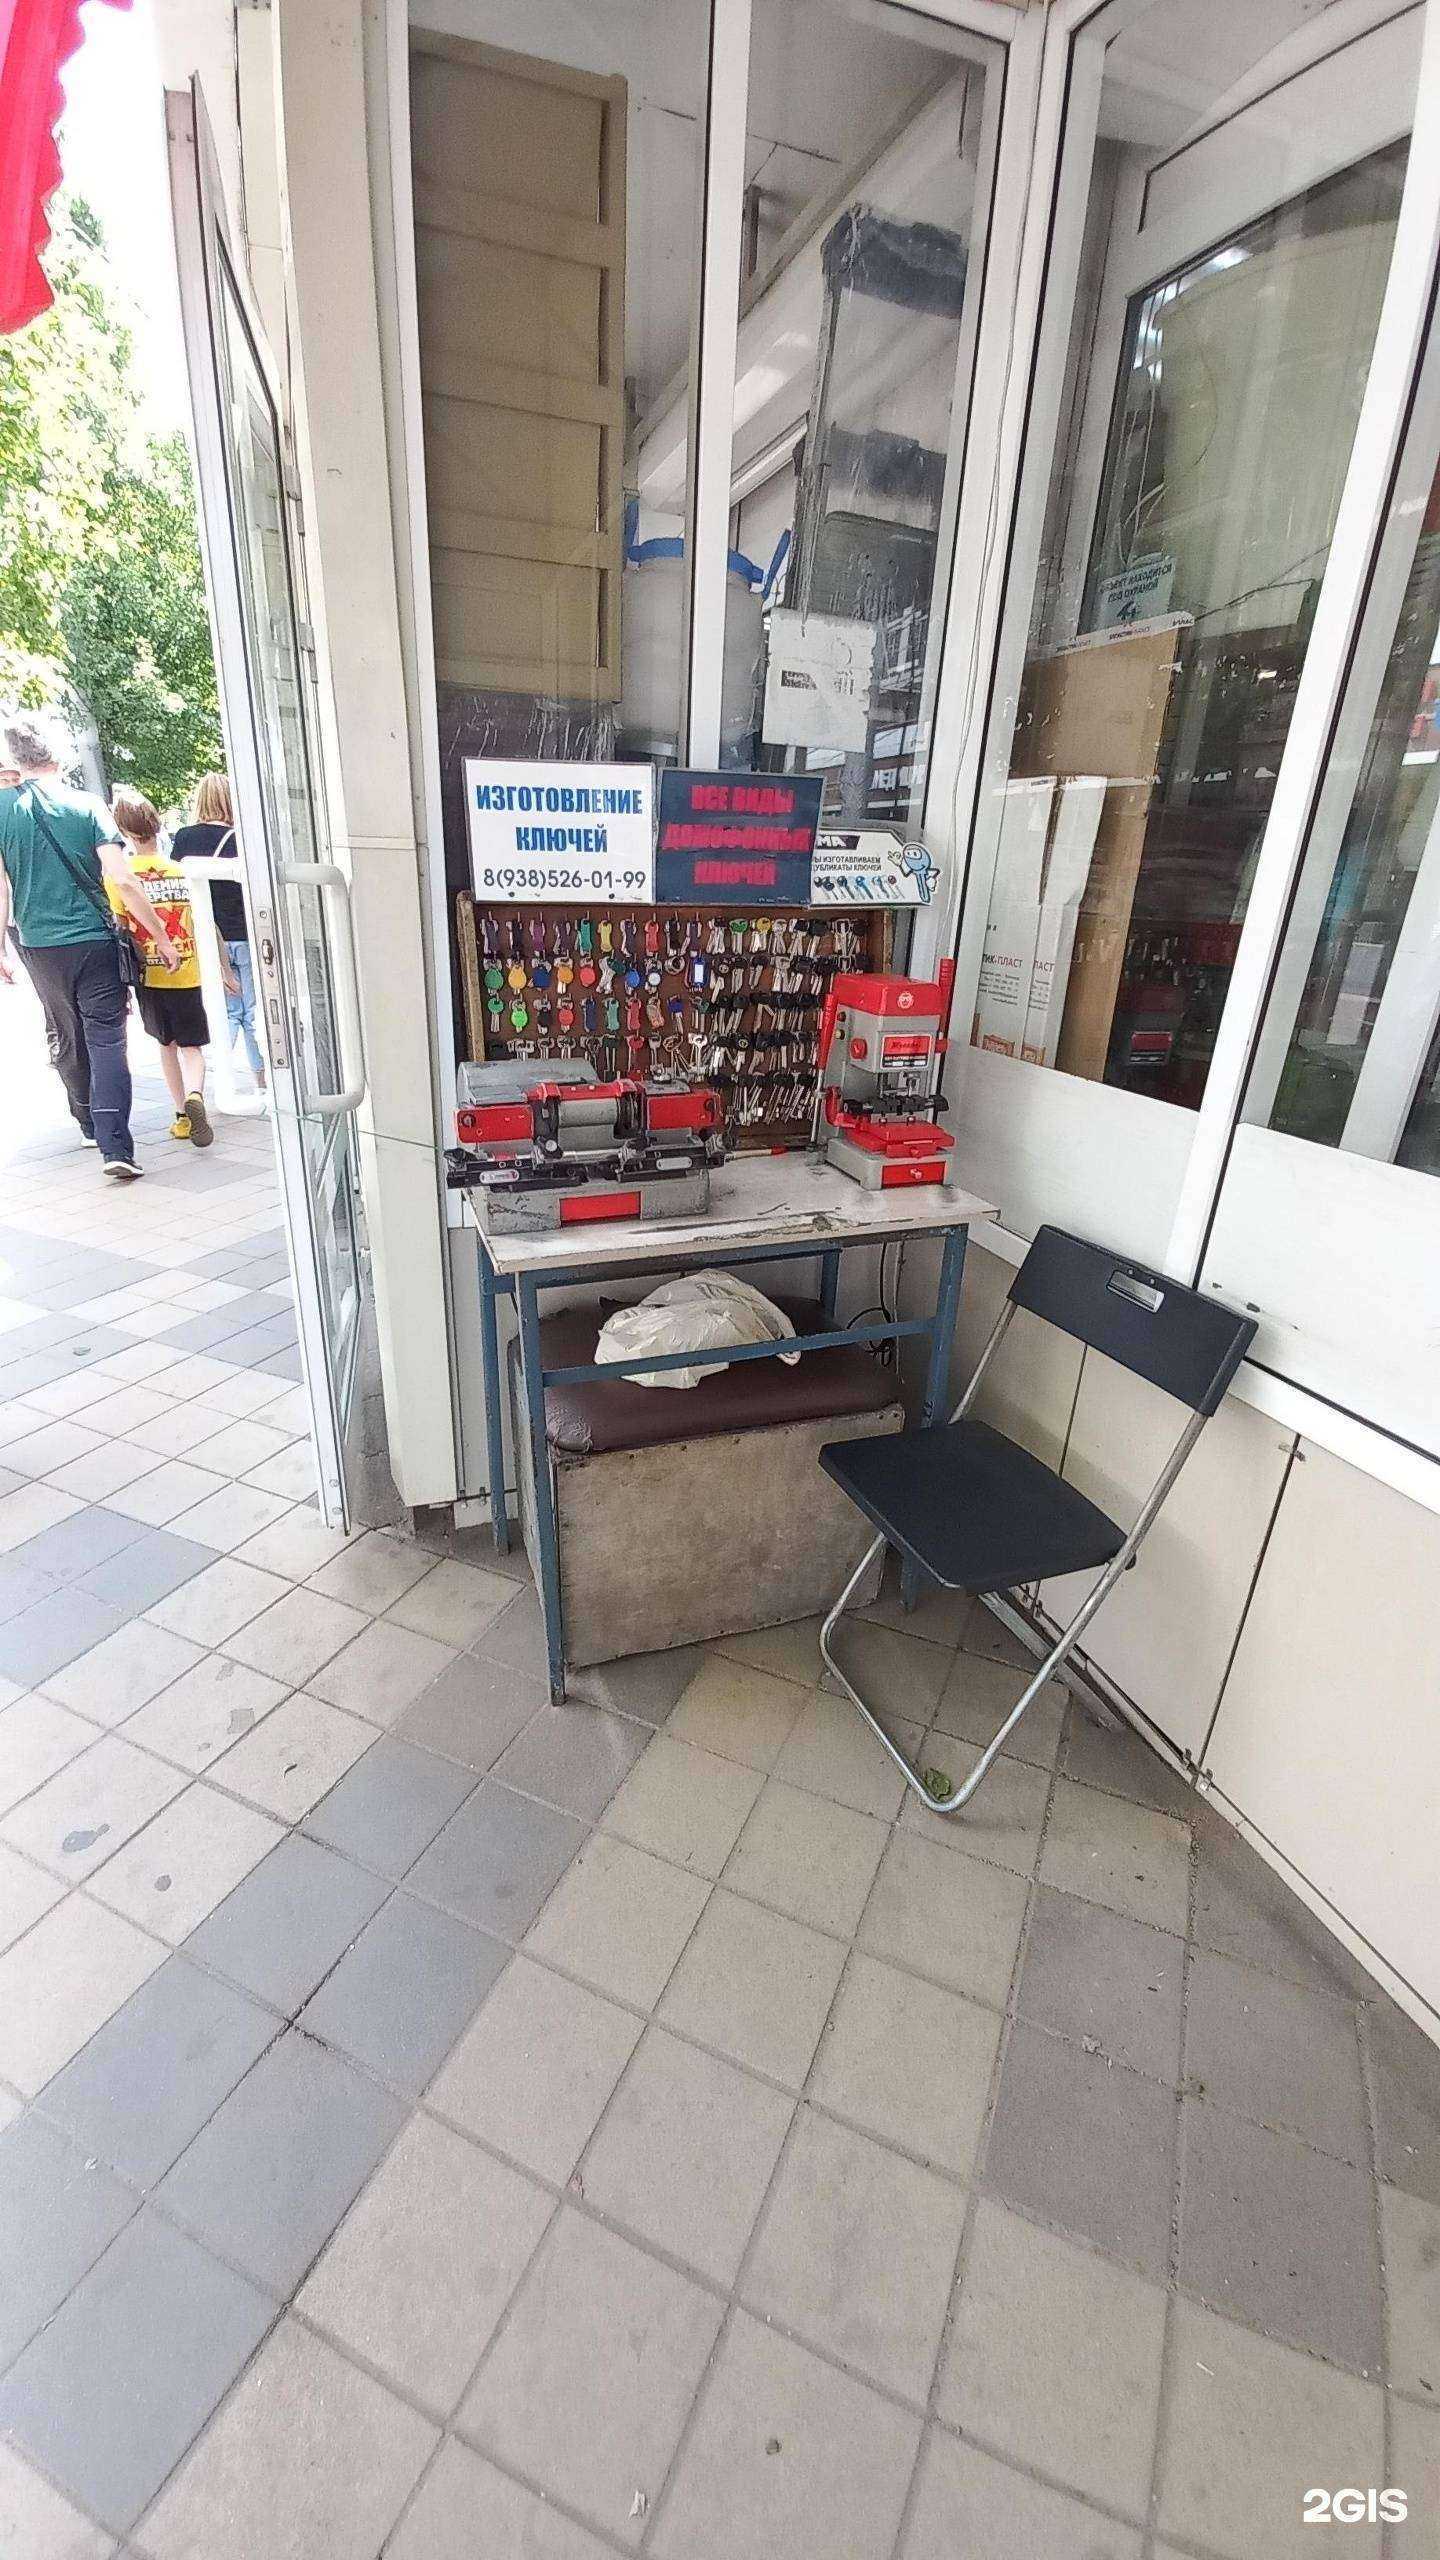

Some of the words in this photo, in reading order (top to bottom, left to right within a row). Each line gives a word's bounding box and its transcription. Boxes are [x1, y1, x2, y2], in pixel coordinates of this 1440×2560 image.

[476, 785, 642, 815] ИЗГОТОВЛЕНИЕ
[515, 823, 608, 853] КЛЮЧЕЙ
[815, 835, 847, 848] MA
[814, 863, 853, 872] УБЛИКАТЫ
[484, 868, 646, 889] 8(938)526-01-99
